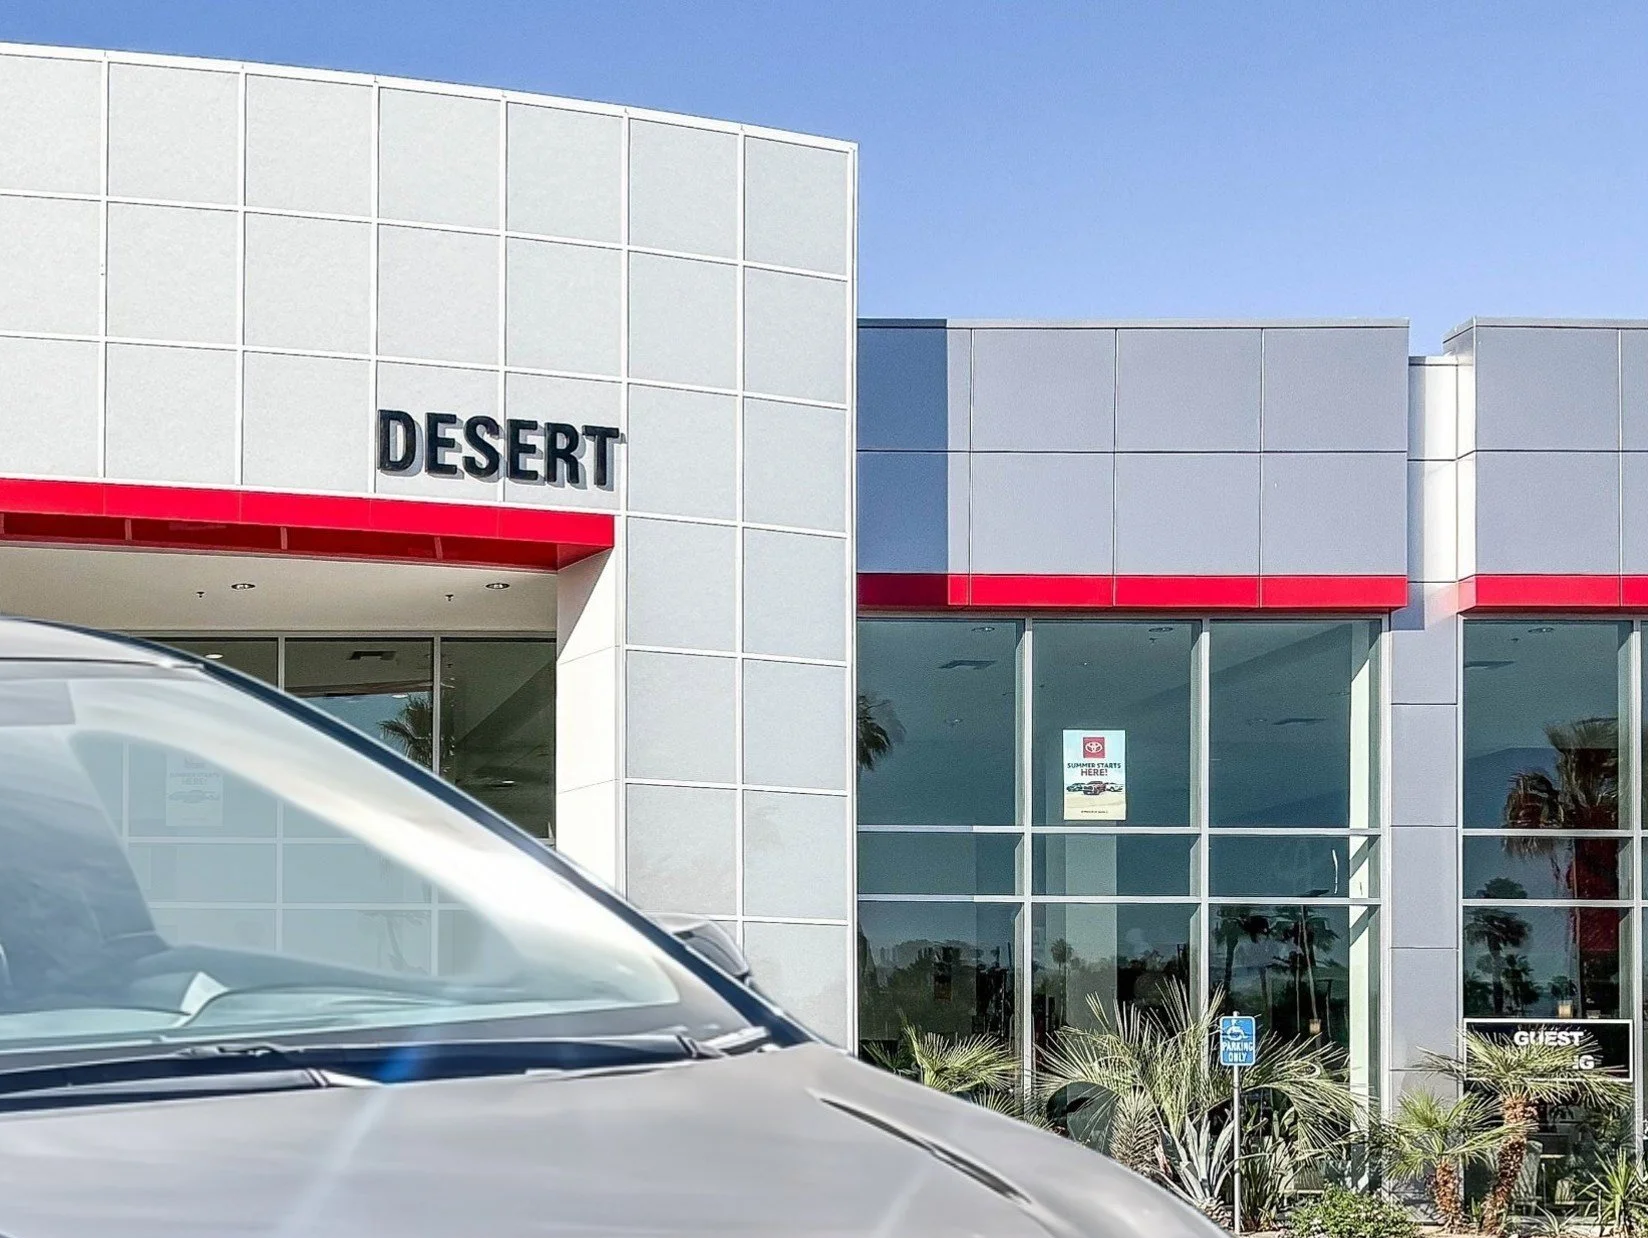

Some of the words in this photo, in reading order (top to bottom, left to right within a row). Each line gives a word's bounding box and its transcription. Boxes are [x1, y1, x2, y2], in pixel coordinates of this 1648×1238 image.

[377, 409, 621, 487] DESERT
[1080, 768, 1108, 777] HERE!
[1513, 1030, 1584, 1047] GUEST
[1221, 1041, 1253, 1051] PARKING
[1228, 1051, 1248, 1063] ONLY
